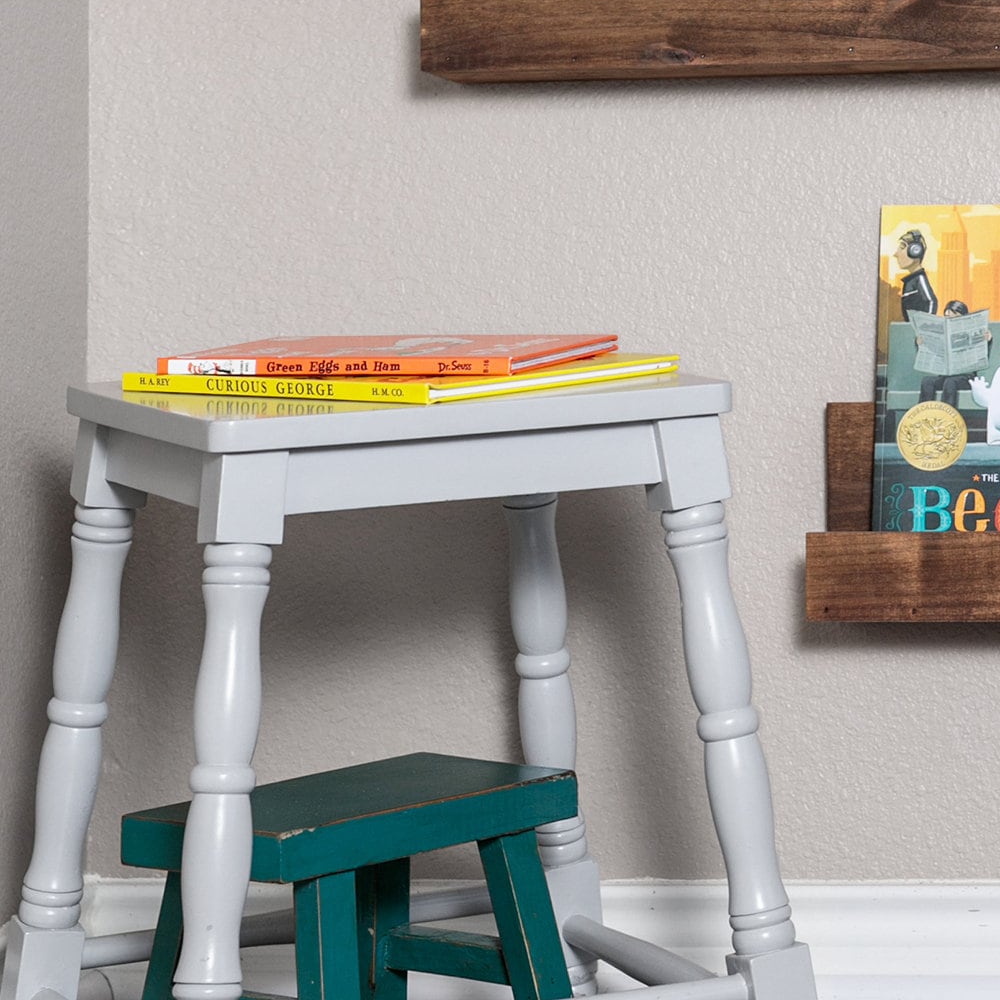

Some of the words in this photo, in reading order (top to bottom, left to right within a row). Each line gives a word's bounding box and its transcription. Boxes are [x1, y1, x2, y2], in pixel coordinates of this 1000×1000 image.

[266, 361, 303, 372] Green
[309, 360, 339, 374] Eggs
[345, 360, 368, 371] and
[373, 361, 401, 371] Ham
[438, 362, 451, 373] Dr.
[451, 360, 472, 371] Seuss
[139, 377, 148, 385] H.
[148, 378, 156, 386] A.
[156, 378, 170, 387] REY
[206, 378, 268, 394] CURIOUS
[276, 382, 335, 397] GEORGE
[371, 388, 380, 396] H.
[391, 388, 404, 397] CO.
[981, 473, 999, 483] THE
